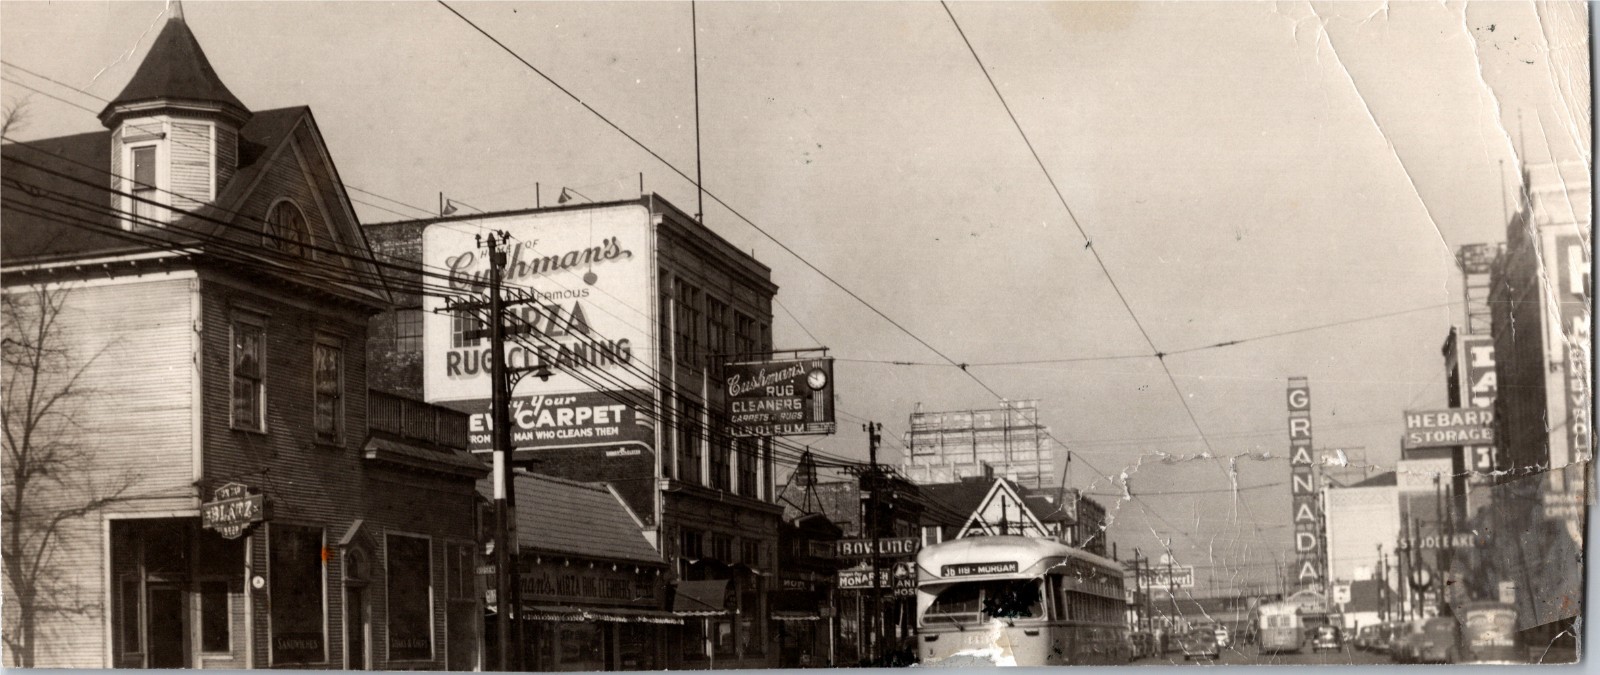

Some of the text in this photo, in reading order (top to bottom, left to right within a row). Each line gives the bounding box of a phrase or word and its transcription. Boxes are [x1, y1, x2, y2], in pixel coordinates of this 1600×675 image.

[525, 239, 540, 248] OF
[445, 236, 632, 292] Cuhman's
[447, 338, 632, 377] RUG CLEANING
[766, 385, 794, 397] RUG
[530, 396, 576, 417] Your
[732, 399, 802, 413] CLEANERS
[516, 404, 626, 429] CARPET
[731, 411, 803, 423] CARPETS RUGS
[1407, 411, 1493, 429] HEBARD
[470, 425, 618, 444] ROM MAN WHO CLEANS THEM
[731, 423, 804, 436] LINOLEUM
[1410, 428, 1493, 444] STORAGE
[1289, 389, 1318, 580] GRANADA
[211, 500, 252, 523] BLATZ
[978, 564, 1016, 574] MORGAN
[839, 571, 889, 587] MONARH
